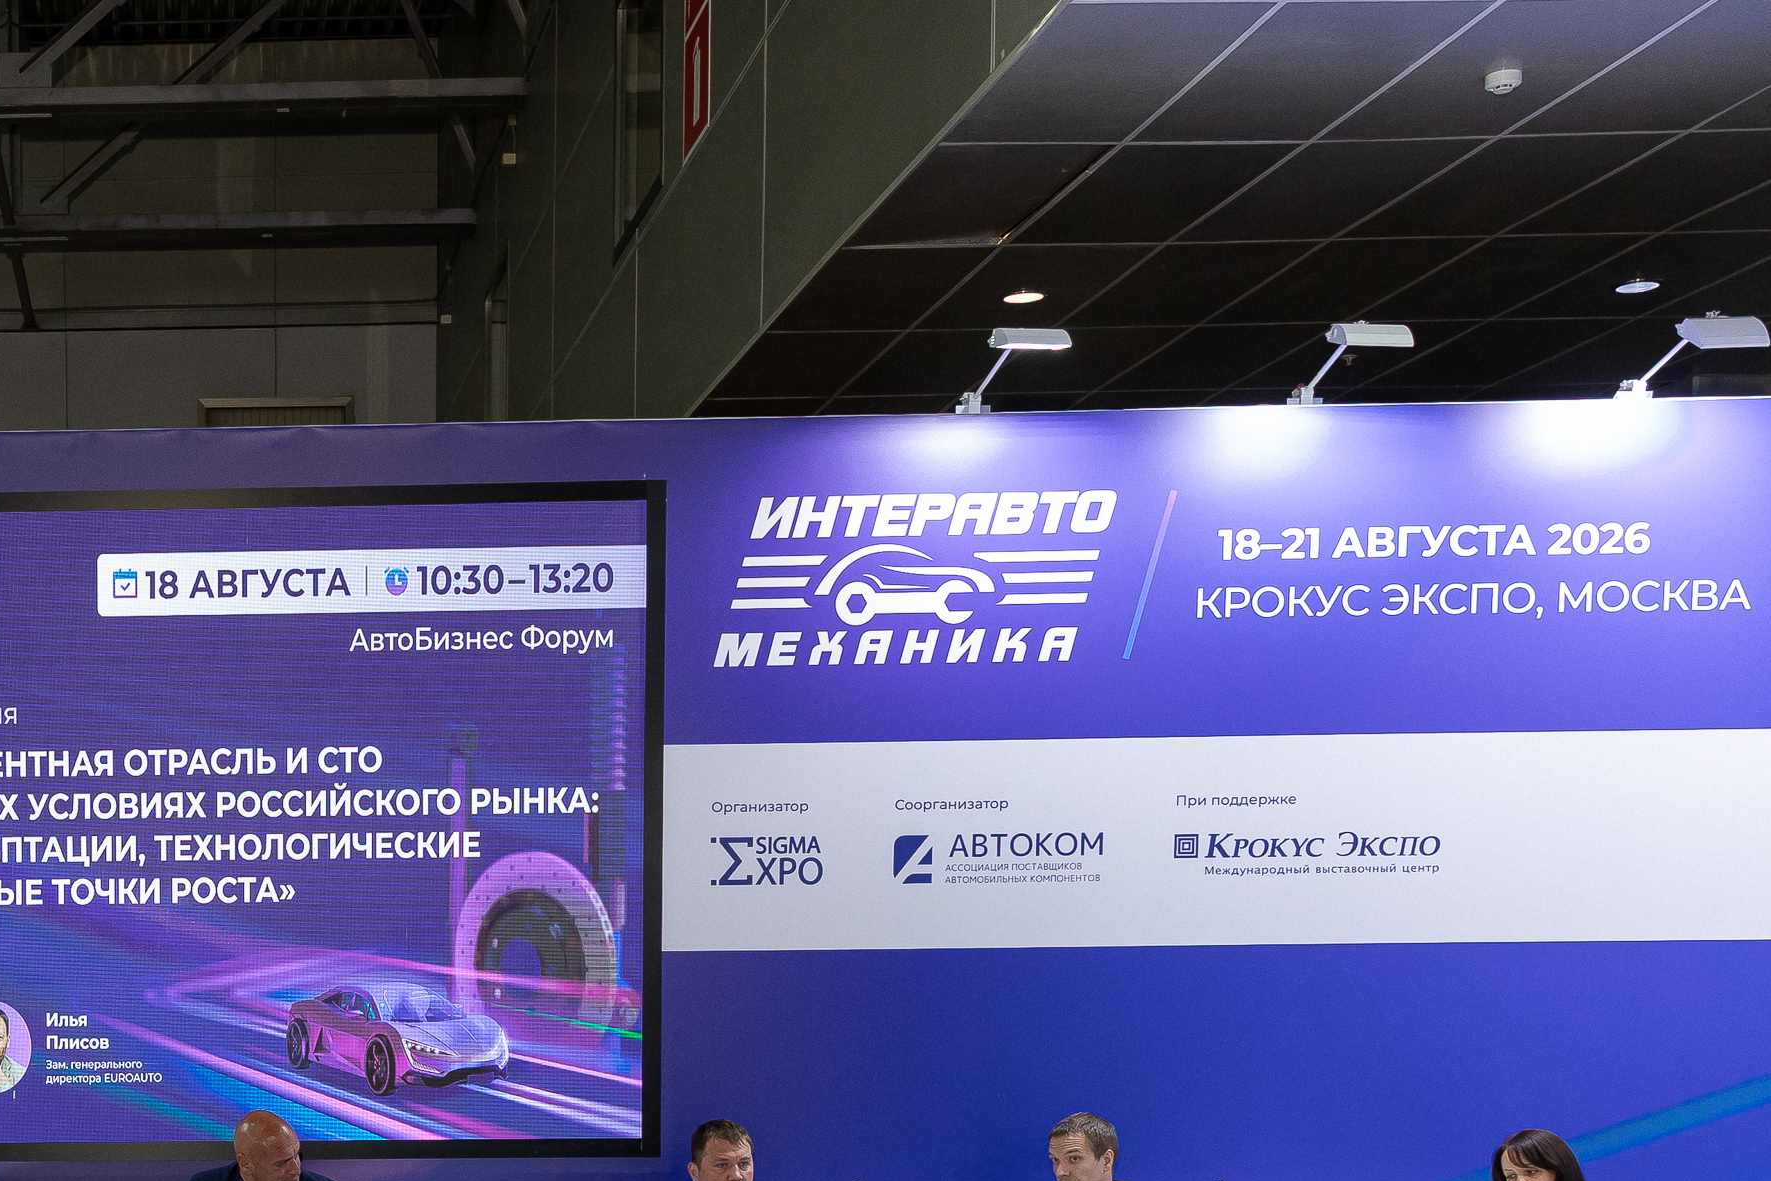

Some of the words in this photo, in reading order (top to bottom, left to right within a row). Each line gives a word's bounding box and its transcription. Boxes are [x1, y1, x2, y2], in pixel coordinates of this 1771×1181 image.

[750, 487, 1118, 539] ИНТЕРАВТО
[1333, 524, 1537, 559] АВГУСТА
[1546, 521, 1651, 555] 2026
[145, 570, 179, 600] 18
[188, 567, 352, 599] АВГУСТА
[1196, 584, 1371, 619] КРОКУС
[1381, 582, 1544, 619] ЭКСПО,
[1561, 579, 1752, 613] МОСКВА
[349, 626, 514, 652] АвтоБизнес
[520, 624, 614, 655] Форум
[714, 627, 1079, 668] МЕХАНИКА
[123, 747, 277, 777] ОТРАСЛЬ
[286, 746, 308, 775] И
[317, 745, 383, 774] СТО
[26, 791, 207, 821] УСЛОВИЯХ
[216, 782, 462, 818] РОССИЙСКОГО
[471, 786, 600, 815] РЫНКА:
[711, 801, 809, 816] Организатор
[894, 799, 1009, 813] Соорганизатор
[1176, 794, 1207, 809] При
[1211, 795, 1297, 808] поддержке
[153, 831, 481, 862] ТЕХНОЛОГИЧЕСКИЕ
[755, 835, 822, 855] SIGMA
[948, 831, 1104, 858] АВТОКОМ
[944, 863, 1009, 873] АССОЦИАЦИЯ
[1011, 862, 1083, 872] ПОСТАВЩИКОВ
[944, 875, 1028, 884] АВТОМОБИЛЬНЫХ
[1029, 873, 1101, 883] КОМПОНЕНТОВ
[1204, 864, 1310, 877] Международный
[1315, 863, 1397, 874] выставочный
[1402, 864, 1440, 874] центр
[51, 877, 161, 906] ТОЧКИ
[171, 876, 296, 904] РОСТА»
[45, 1012, 88, 1028] Илья
[46, 1034, 110, 1050] Плисов
[43, 1058, 68, 1071] Зам.
[70, 1059, 144, 1072] генерального
[45, 1074, 102, 1086] директора
[103, 1072, 163, 1084] EUROAUTO
